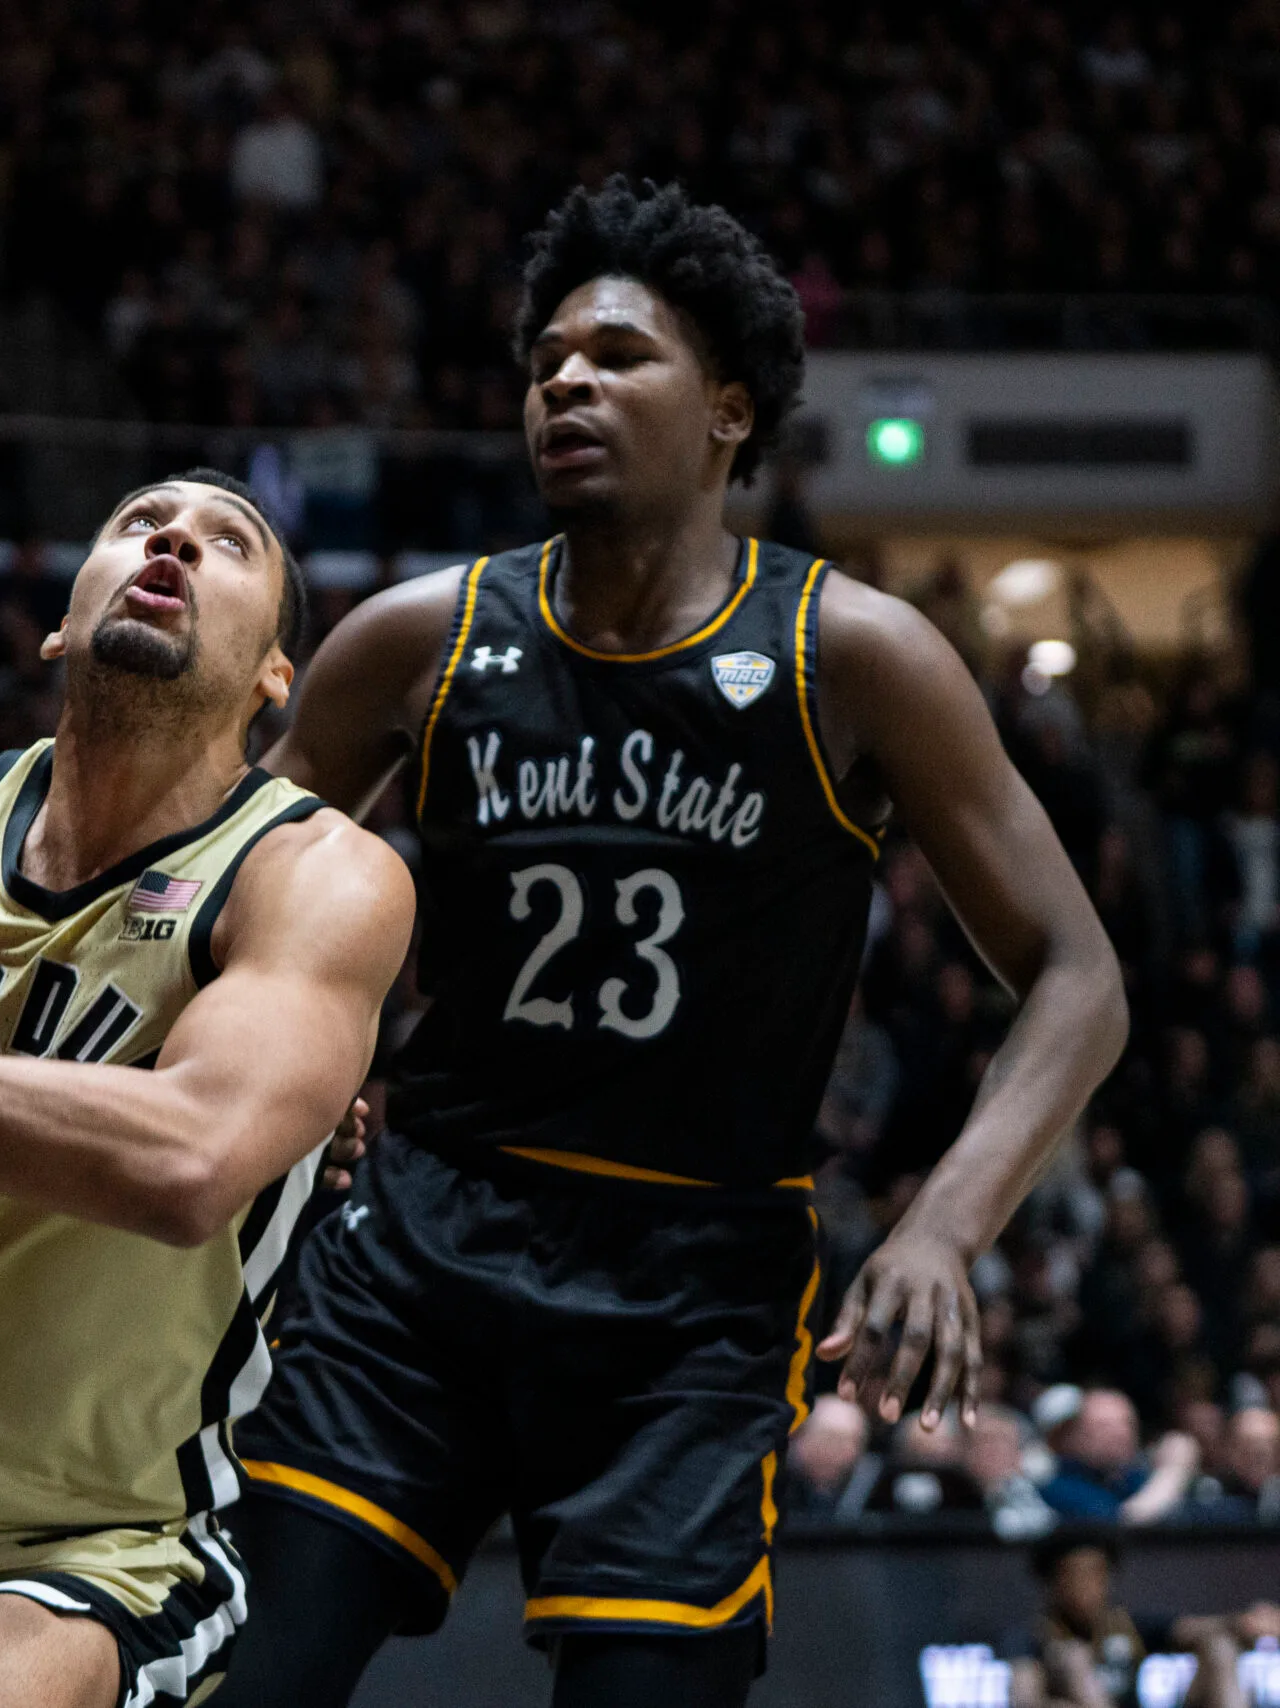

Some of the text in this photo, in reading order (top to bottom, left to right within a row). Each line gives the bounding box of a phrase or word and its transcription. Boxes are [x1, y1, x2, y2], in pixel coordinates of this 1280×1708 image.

[716, 667, 770, 684] MAC
[466, 728, 768, 849] Kent State
[502, 863, 686, 1040] 23
